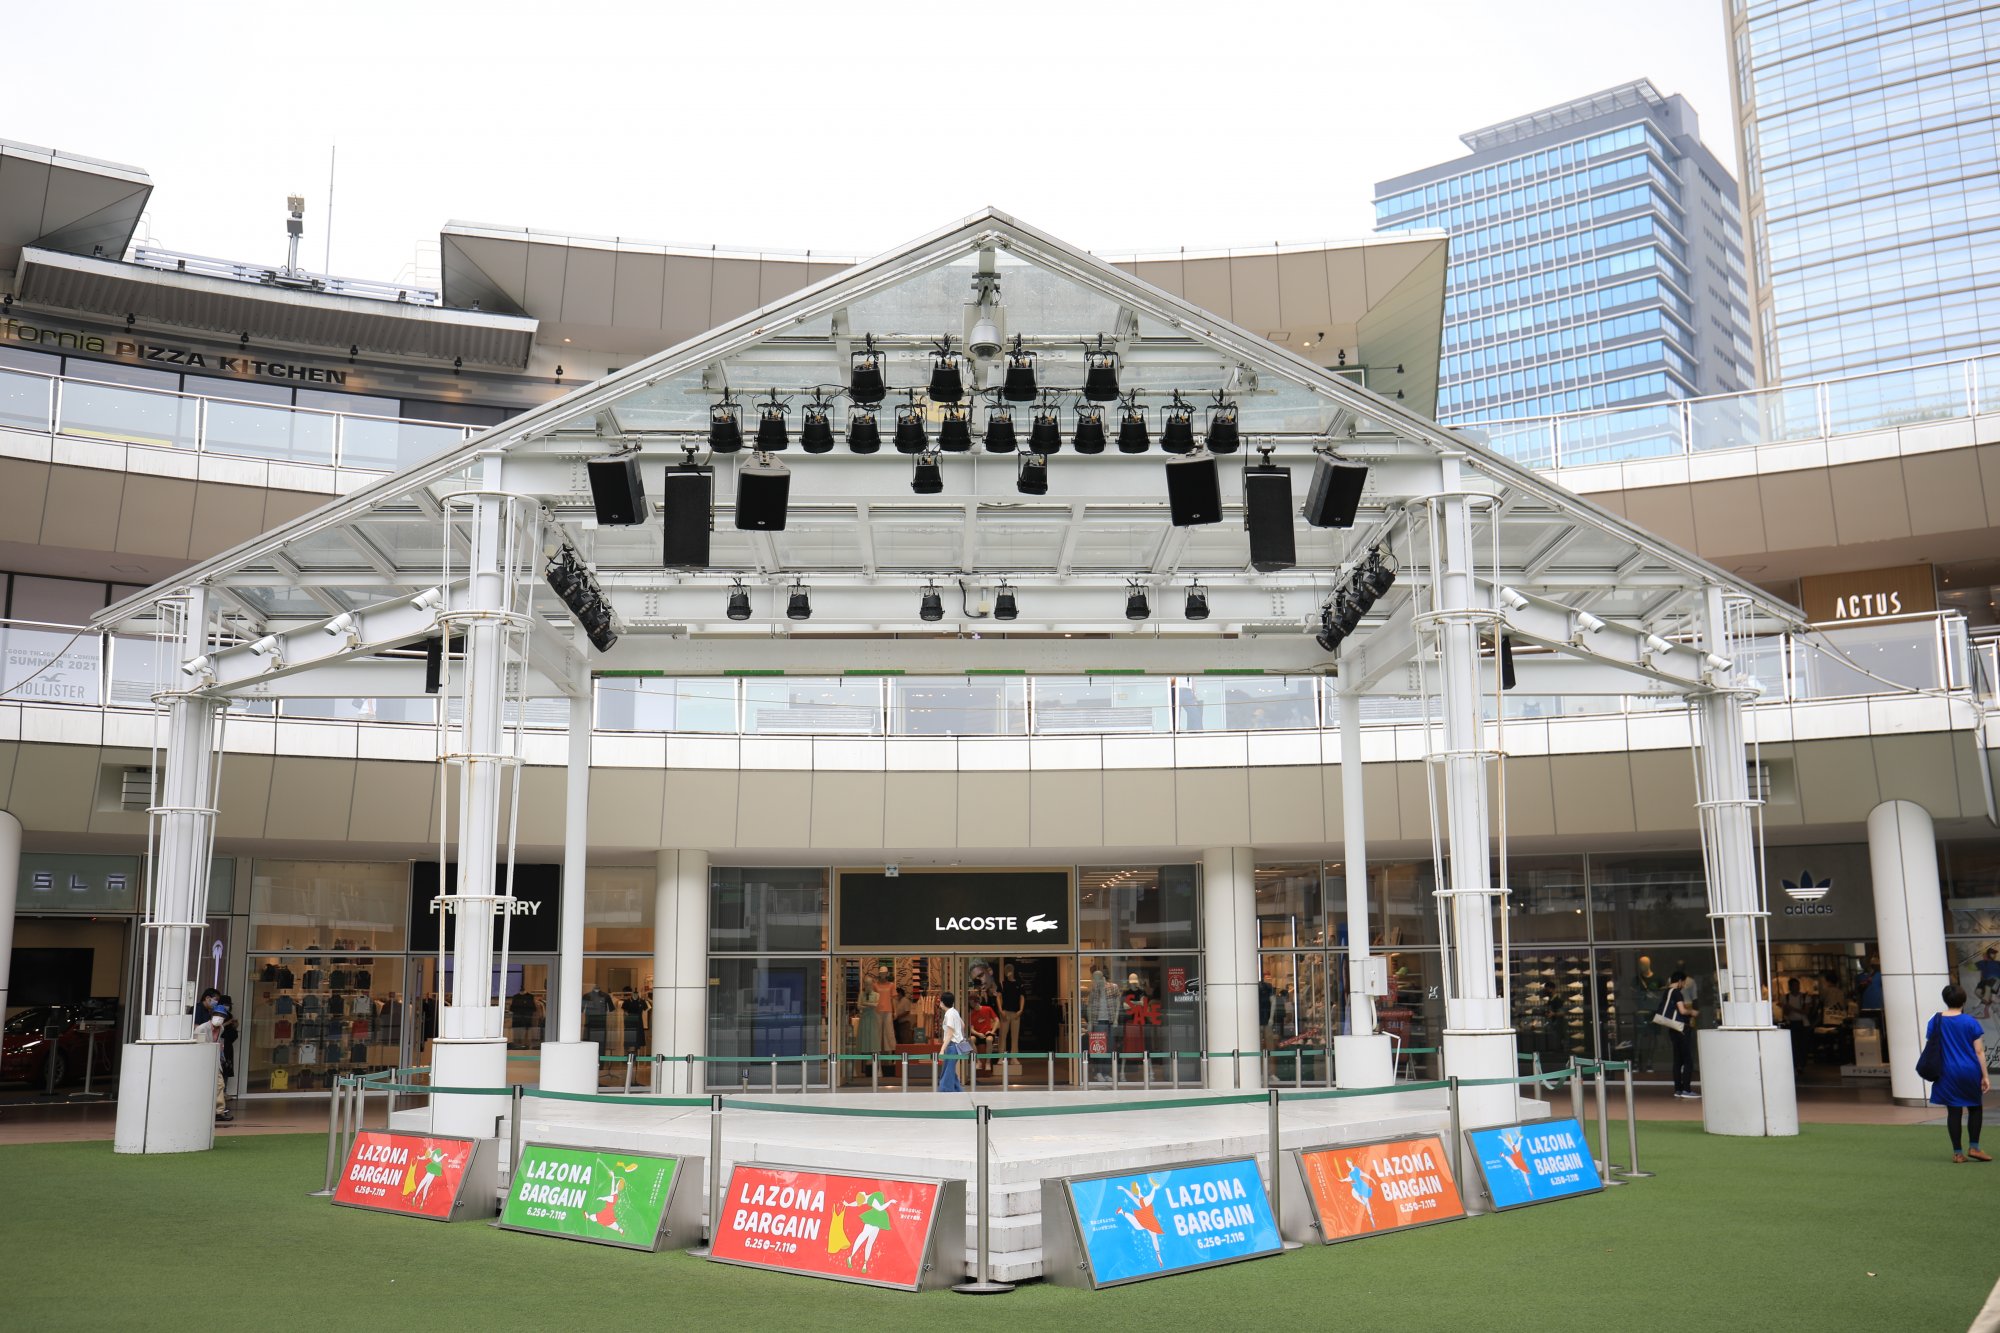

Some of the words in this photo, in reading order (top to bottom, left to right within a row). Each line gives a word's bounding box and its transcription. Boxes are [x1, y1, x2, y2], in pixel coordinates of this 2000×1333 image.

[0, 317, 105, 353] fornia
[116, 341, 206, 367] PIZZA
[219, 356, 347, 384] KITCHEN
[1835, 591, 1902, 619] ACTUS
[9, 656, 64, 669] SUMMER
[68, 661, 97, 671] 2021
[16, 681, 85, 699] HOLLISTER
[32, 873, 126, 890] SLA
[1784, 902, 1833, 915] adidas
[935, 917, 1018, 931] LACOSTE
[1124, 994, 1162, 1025] SALE
[357, 1144, 409, 1165] LAZONA
[1526, 1133, 1576, 1155] LAZONA
[350, 1164, 402, 1186] BARGAIN
[526, 1159, 592, 1185] LAZONA
[1372, 1152, 1435, 1178] LAZONA
[1533, 1152, 1584, 1175] BARGAIN
[519, 1183, 587, 1208] BARGAIN
[740, 1183, 825, 1212] LAZONA
[1165, 1177, 1246, 1209] LAZONA
[1380, 1174, 1443, 1201] BARGAIN
[732, 1209, 821, 1240] BARGAIN
[1173, 1203, 1255, 1236] BARGAIN
